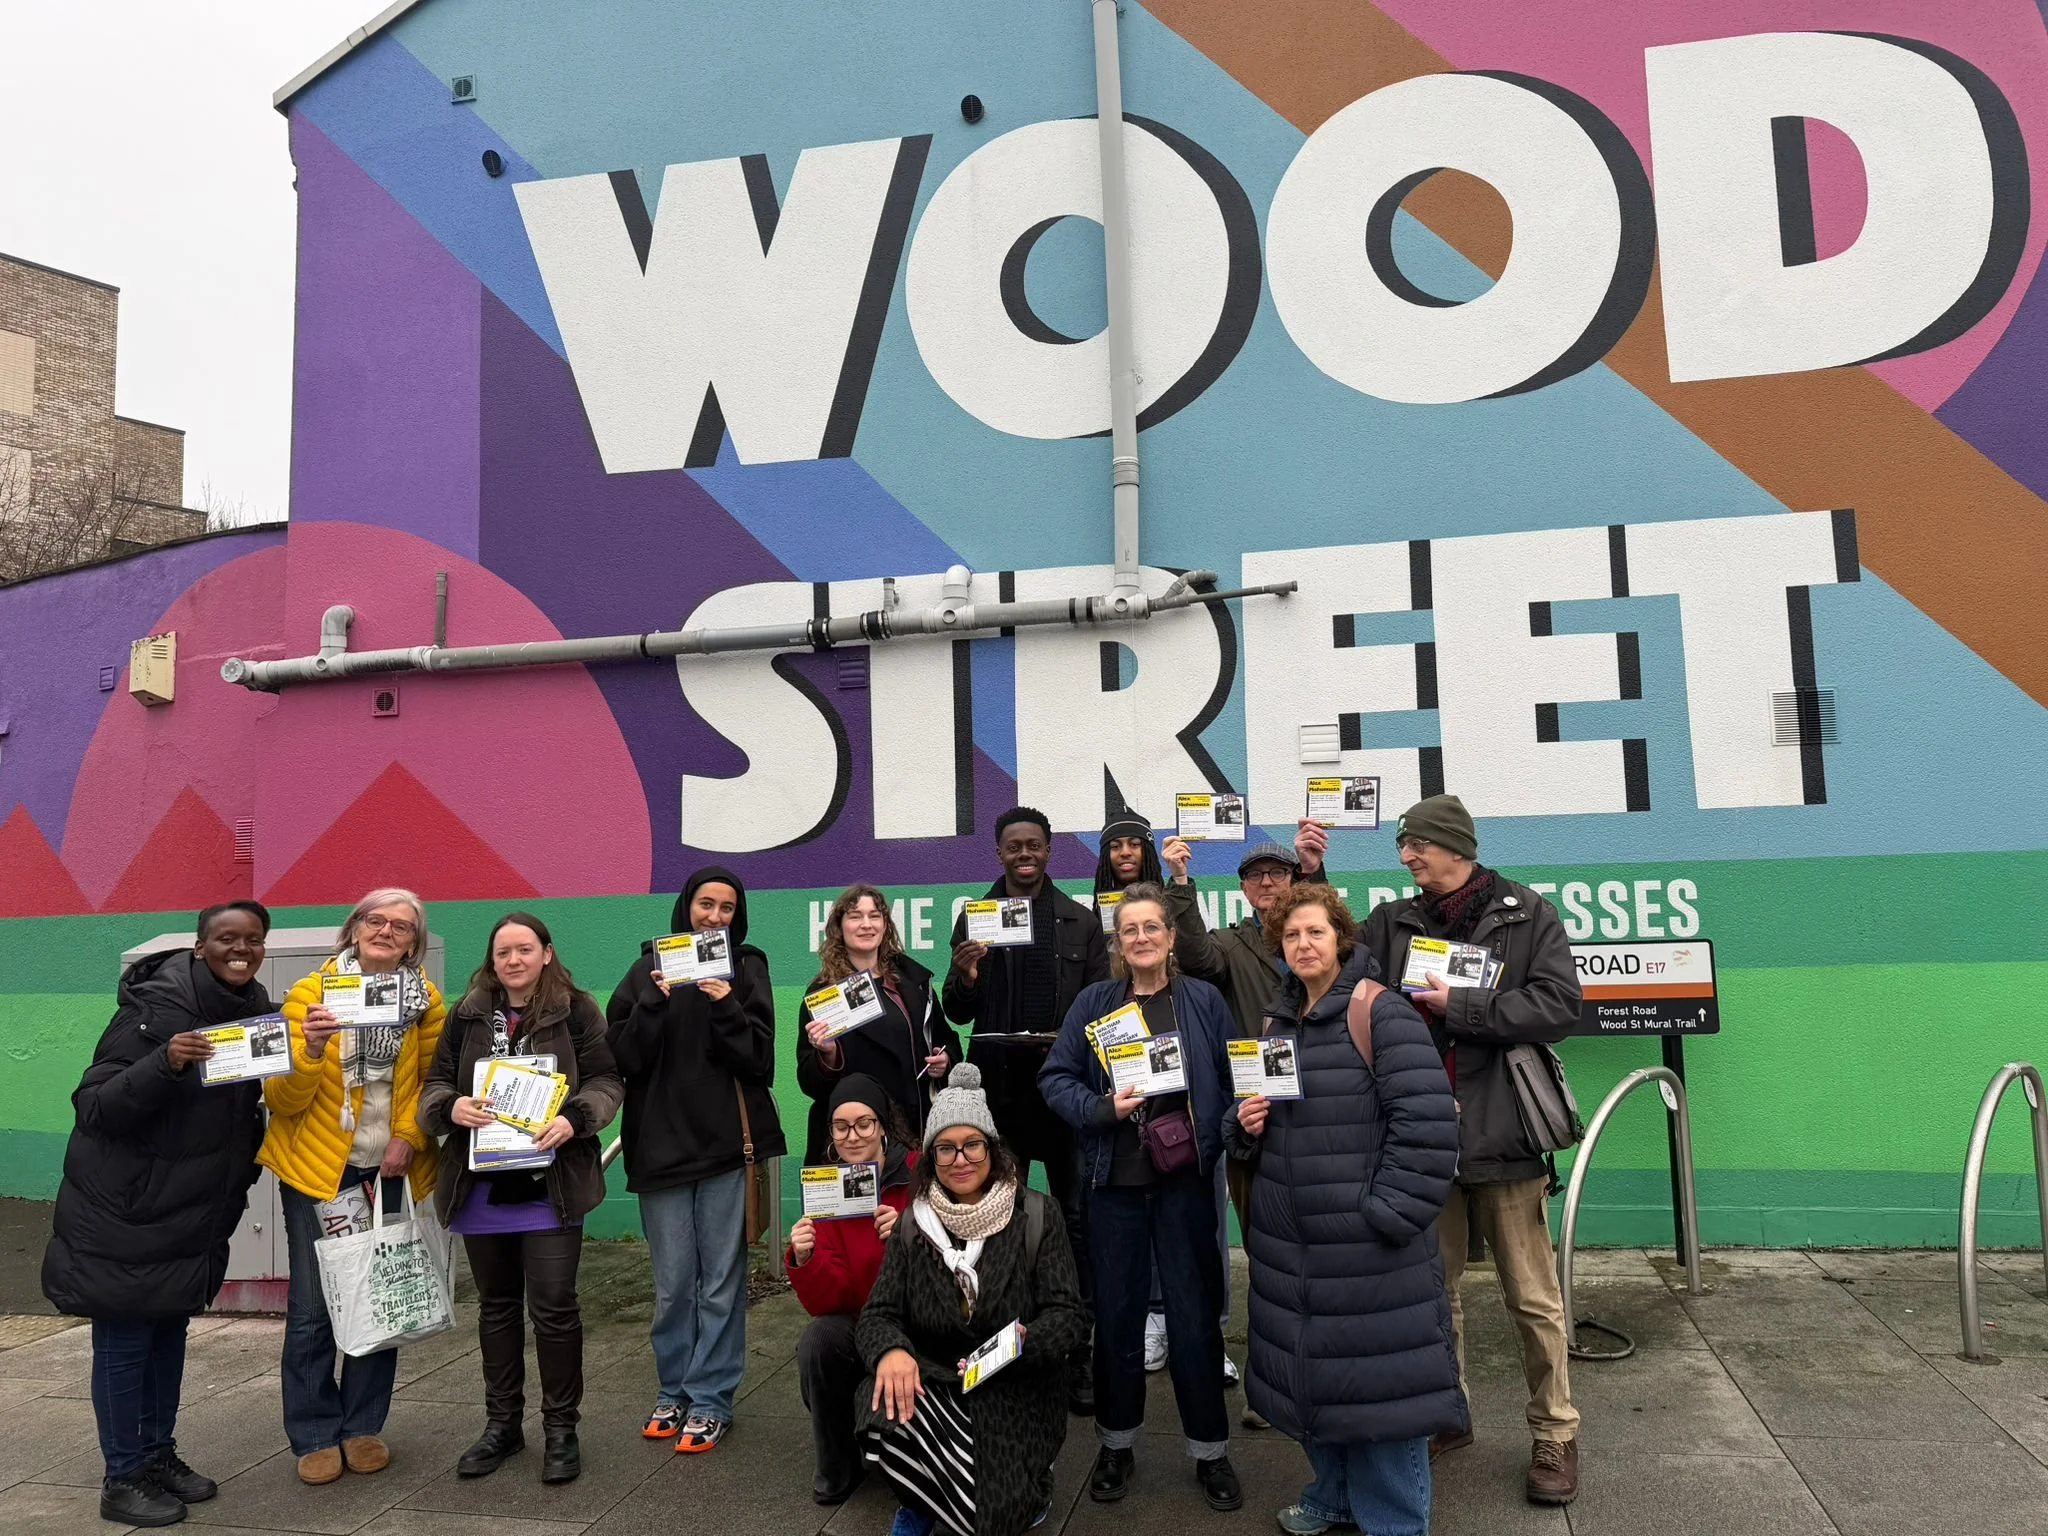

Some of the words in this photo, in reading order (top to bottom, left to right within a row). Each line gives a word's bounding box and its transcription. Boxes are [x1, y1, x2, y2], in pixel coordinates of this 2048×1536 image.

[512, 31, 2030, 474] WOOD
[677, 509, 1860, 853] STREET
[809, 897, 934, 952] HE
[1573, 954, 1641, 975] ROAD
[1646, 962, 1666, 974] E17
[1598, 1006, 1629, 1016] Forest
[1633, 1006, 1657, 1015] Road
[1600, 1020, 1627, 1030] Wood
[1630, 1020, 1641, 1029] St
[1644, 1019, 1672, 1029] Mural
[1675, 1018, 1697, 1028] Trail
